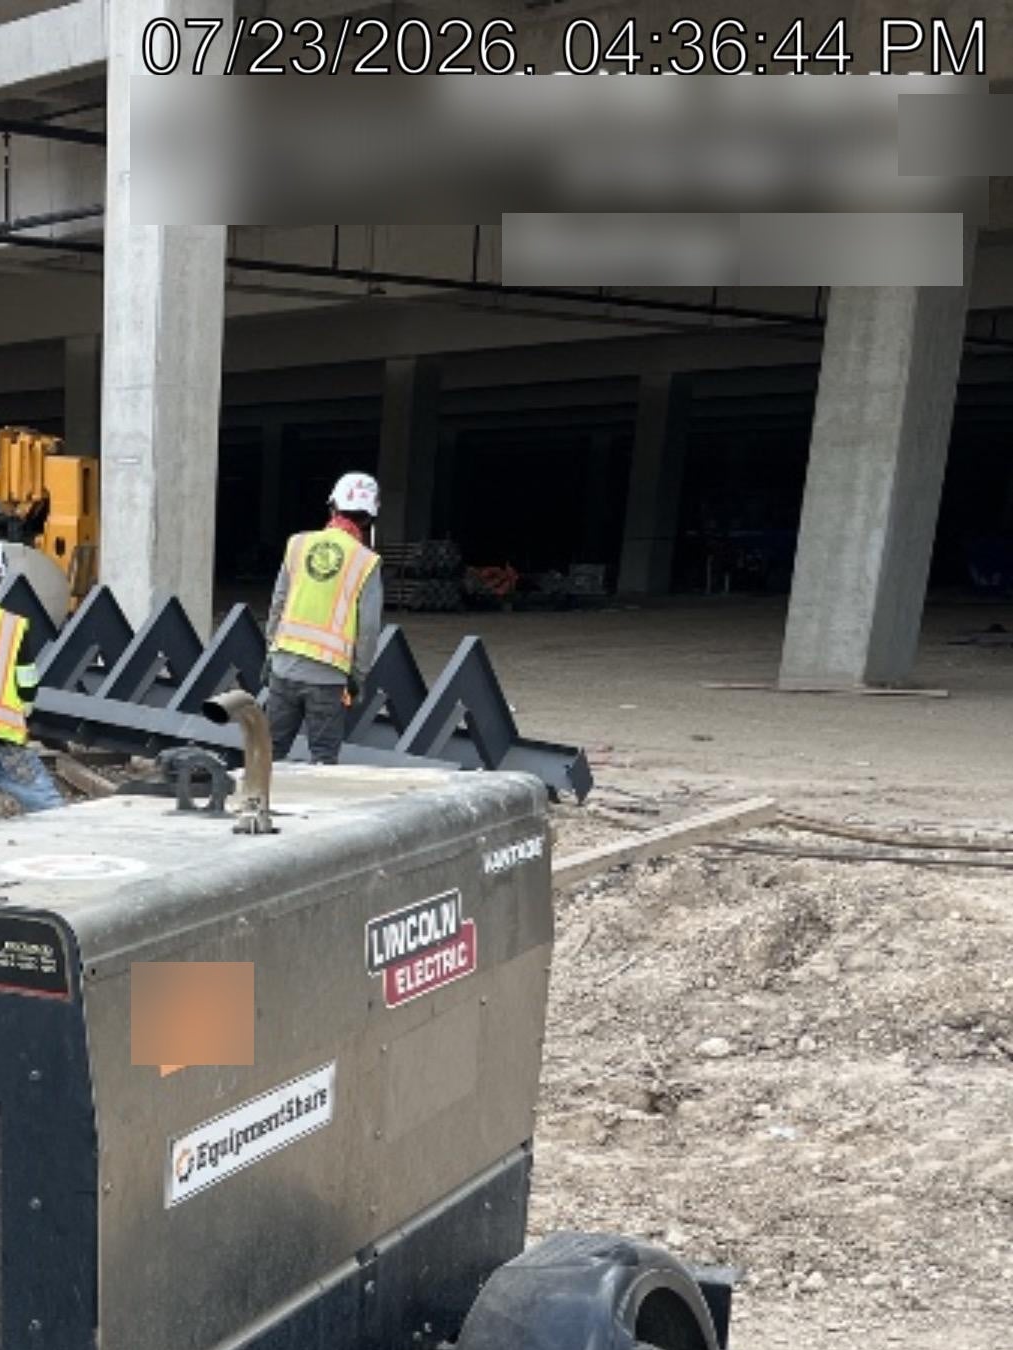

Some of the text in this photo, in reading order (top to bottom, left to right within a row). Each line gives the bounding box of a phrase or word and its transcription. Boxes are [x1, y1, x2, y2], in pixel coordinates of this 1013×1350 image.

[371, 898, 457, 967] LINCOLN
[394, 941, 468, 994] ELECTRIC
[196, 1088, 328, 1170] EquipmentShare
